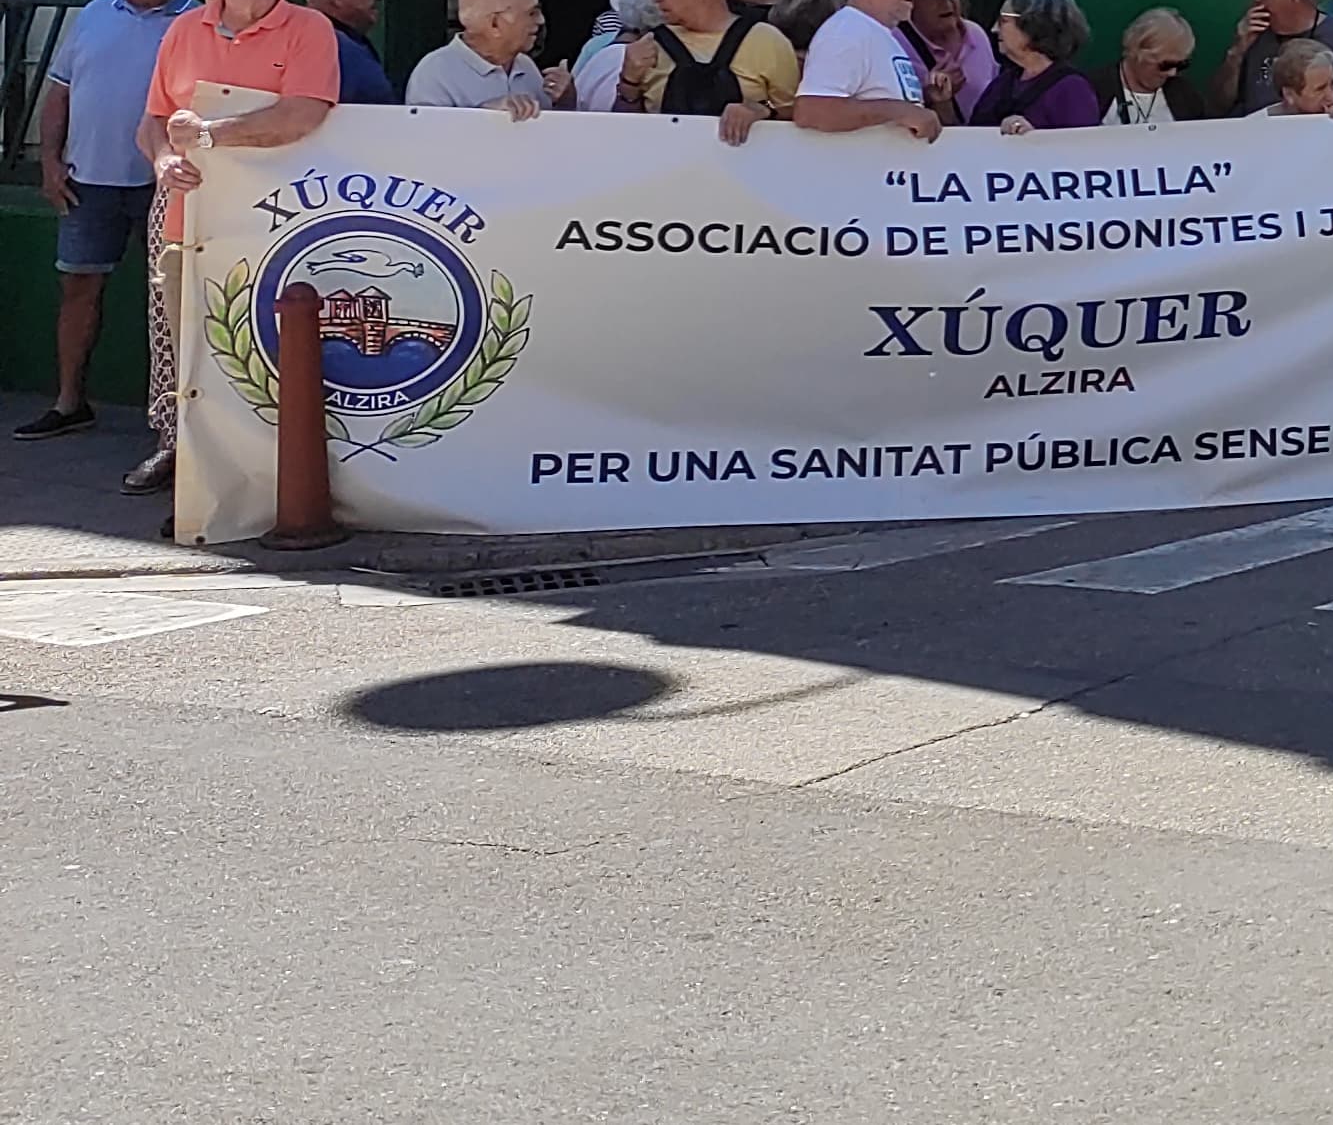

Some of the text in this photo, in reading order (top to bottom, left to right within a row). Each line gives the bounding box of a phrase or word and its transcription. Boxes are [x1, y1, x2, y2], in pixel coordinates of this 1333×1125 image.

[253, 169, 486, 244] XÚQUER
[556, 219, 869, 256] ASSOCIACIÓ
[887, 226, 949, 256] DE
[964, 212, 1282, 254] PENSIONISTES
[1297, 211, 1305, 238] I
[863, 287, 1251, 362] XÚQUER
[328, 391, 411, 410] ALZIRA
[984, 367, 1134, 399] ALZIRA
[531, 452, 629, 484] PER
[648, 450, 756, 482] UNA
[770, 444, 971, 480] SANITAT
[985, 433, 1181, 473] PÚBLICA
[1194, 425, 1330, 461] SENSE
